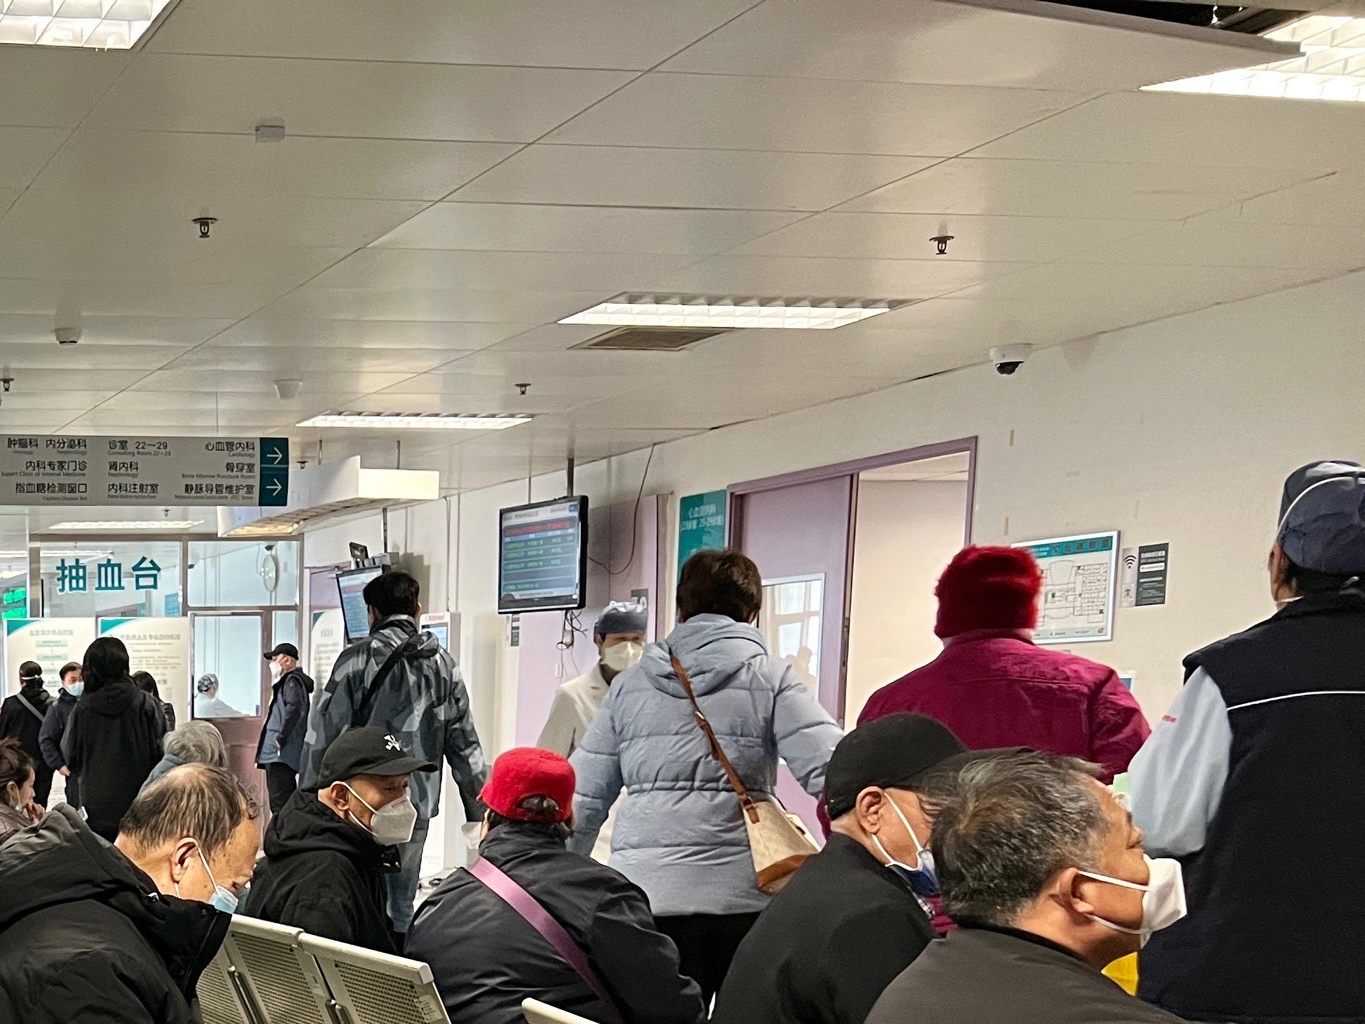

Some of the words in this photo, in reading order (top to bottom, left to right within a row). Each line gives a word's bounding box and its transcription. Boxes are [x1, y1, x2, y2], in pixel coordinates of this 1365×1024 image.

[7, 438, 38, 449] 肿瘤科
[46, 438, 87, 449] 内分泌科
[108, 440, 128, 450] 诊室
[205, 441, 255, 451] 心血管内科
[26, 461, 87, 471] 内科专家门诊
[109, 461, 138, 471] 肾内科
[16, 483, 87, 493] 指血糖检测窗口
[108, 483, 159, 493] 内科注射室
[185, 484, 255, 494] 静脉导管维护室
[56, 556, 161, 593] 抽血台
